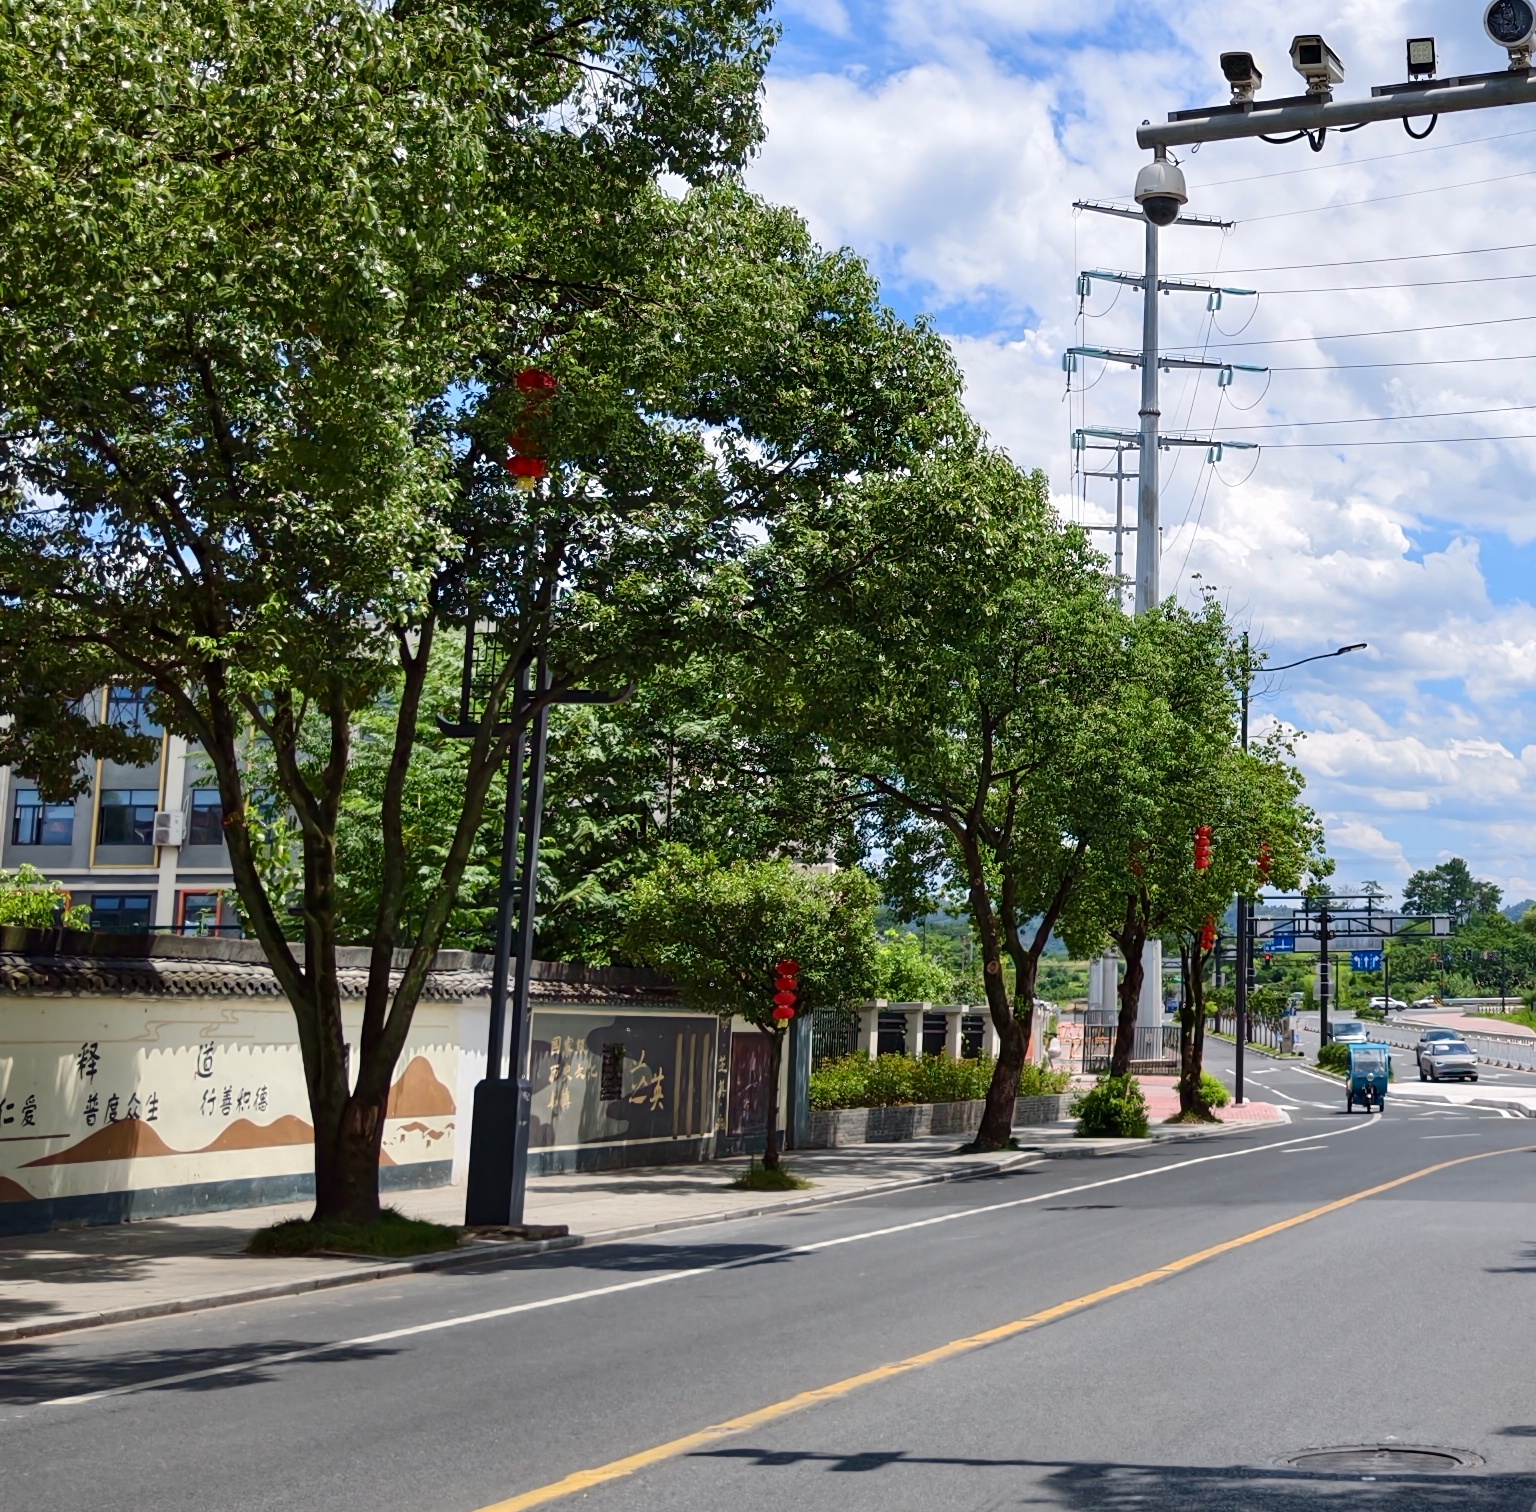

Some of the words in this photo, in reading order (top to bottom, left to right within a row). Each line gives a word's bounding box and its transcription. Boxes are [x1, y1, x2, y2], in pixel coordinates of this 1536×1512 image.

[77, 1041, 101, 1086] 释
[194, 1041, 215, 1079] 道
[0, 1093, 38, 1128] 仁爱
[83, 1091, 159, 1127] 普度众生
[200, 1085, 269, 1117] 行善积德
